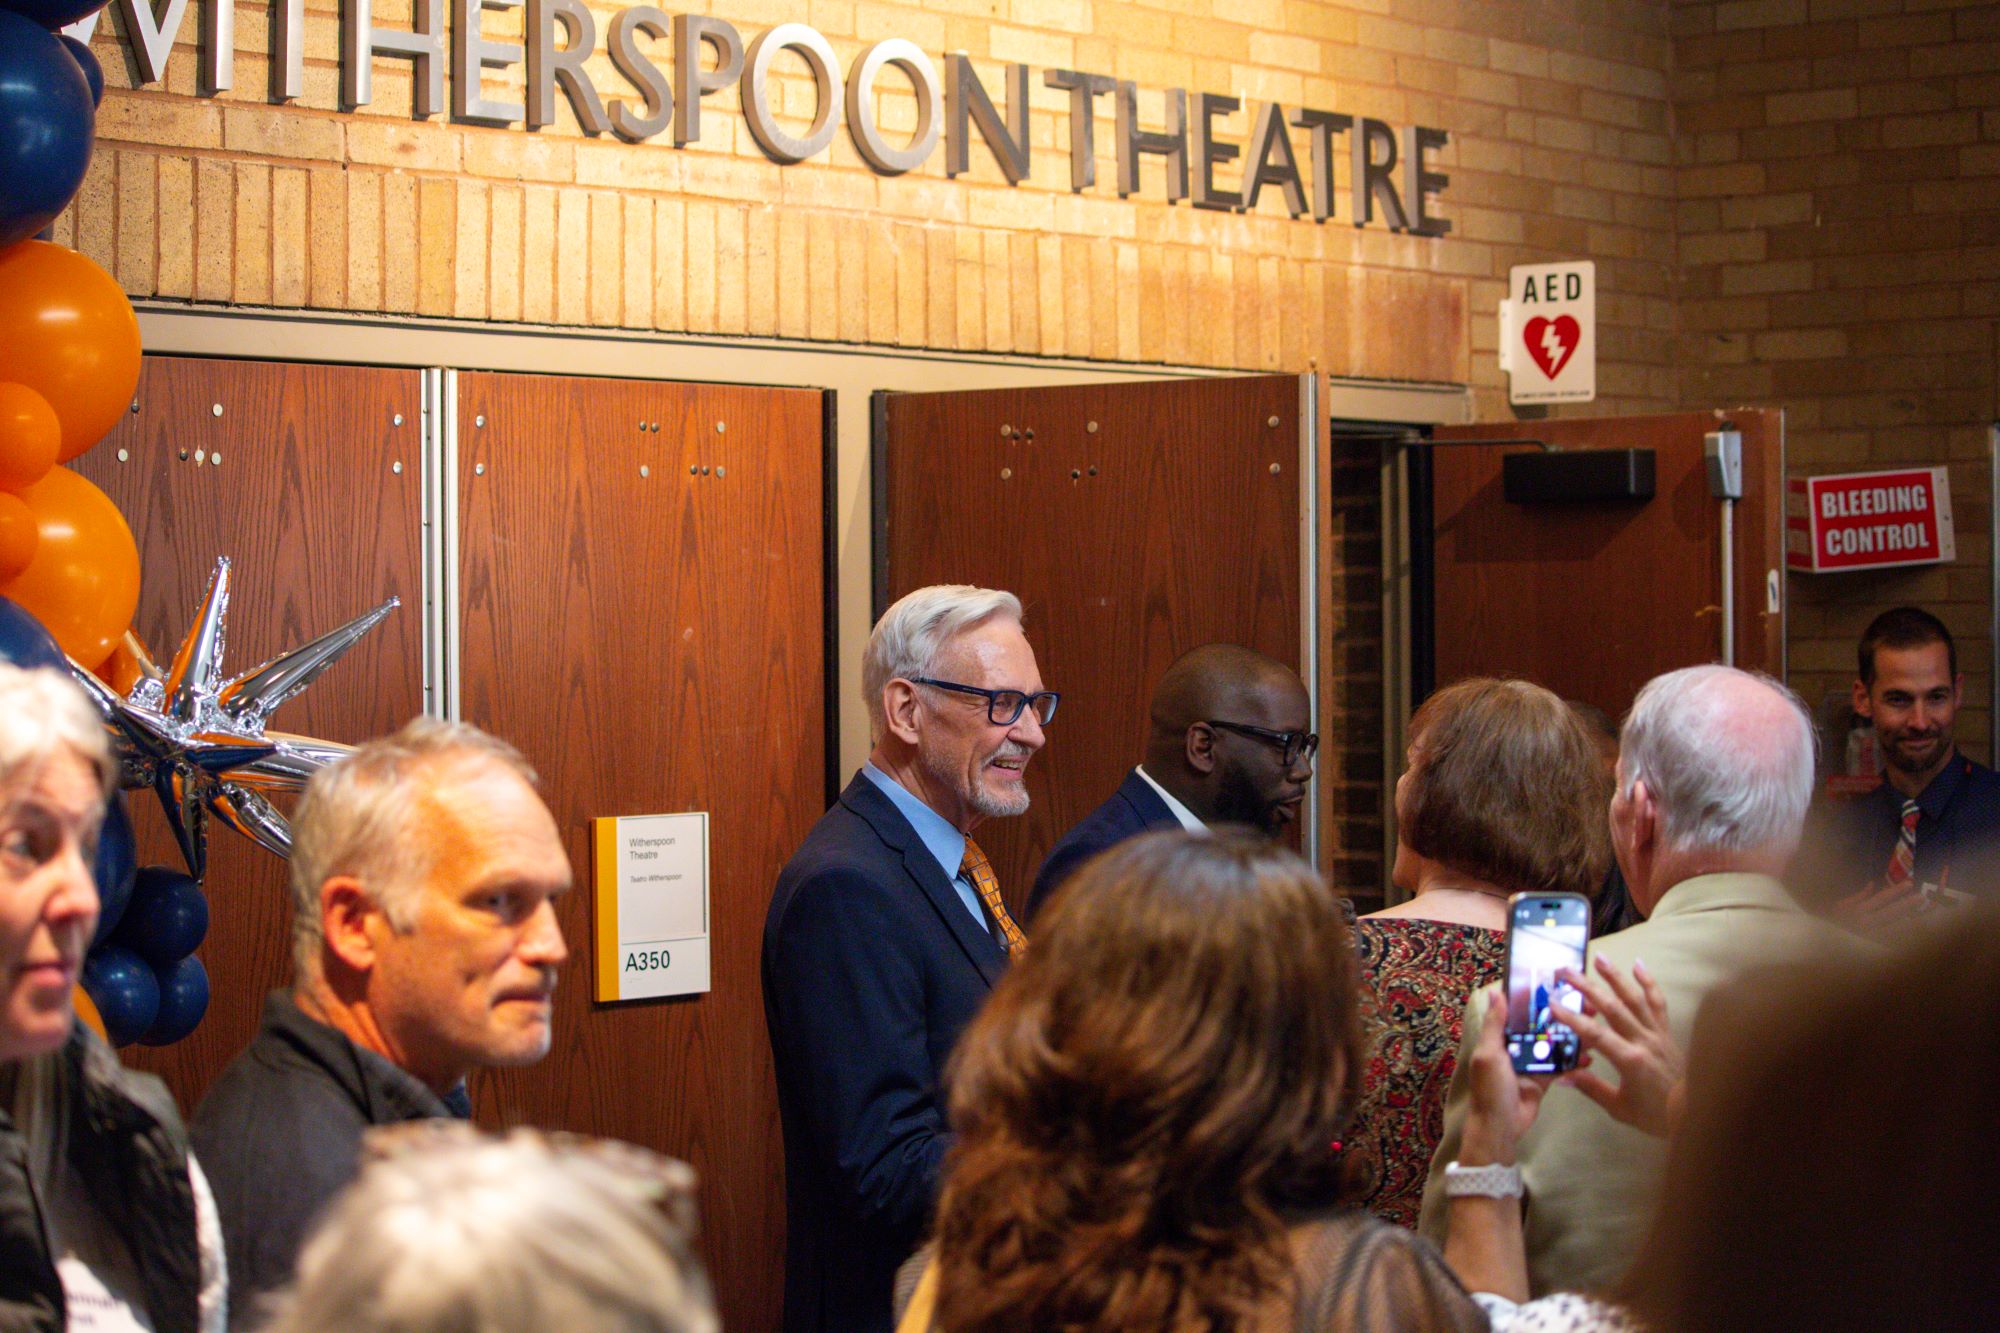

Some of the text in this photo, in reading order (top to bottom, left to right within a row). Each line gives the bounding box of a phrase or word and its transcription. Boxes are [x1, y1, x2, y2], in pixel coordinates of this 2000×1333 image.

[1043, 68, 1452, 237] THEATRE
[1523, 272, 1582, 304] AED
[1821, 484, 1928, 519] BLEEDING
[1825, 522, 1930, 556] CONTROL
[629, 837, 676, 848] Witherspoon
[629, 850, 659, 861] Theatre
[625, 949, 671, 973] A350
